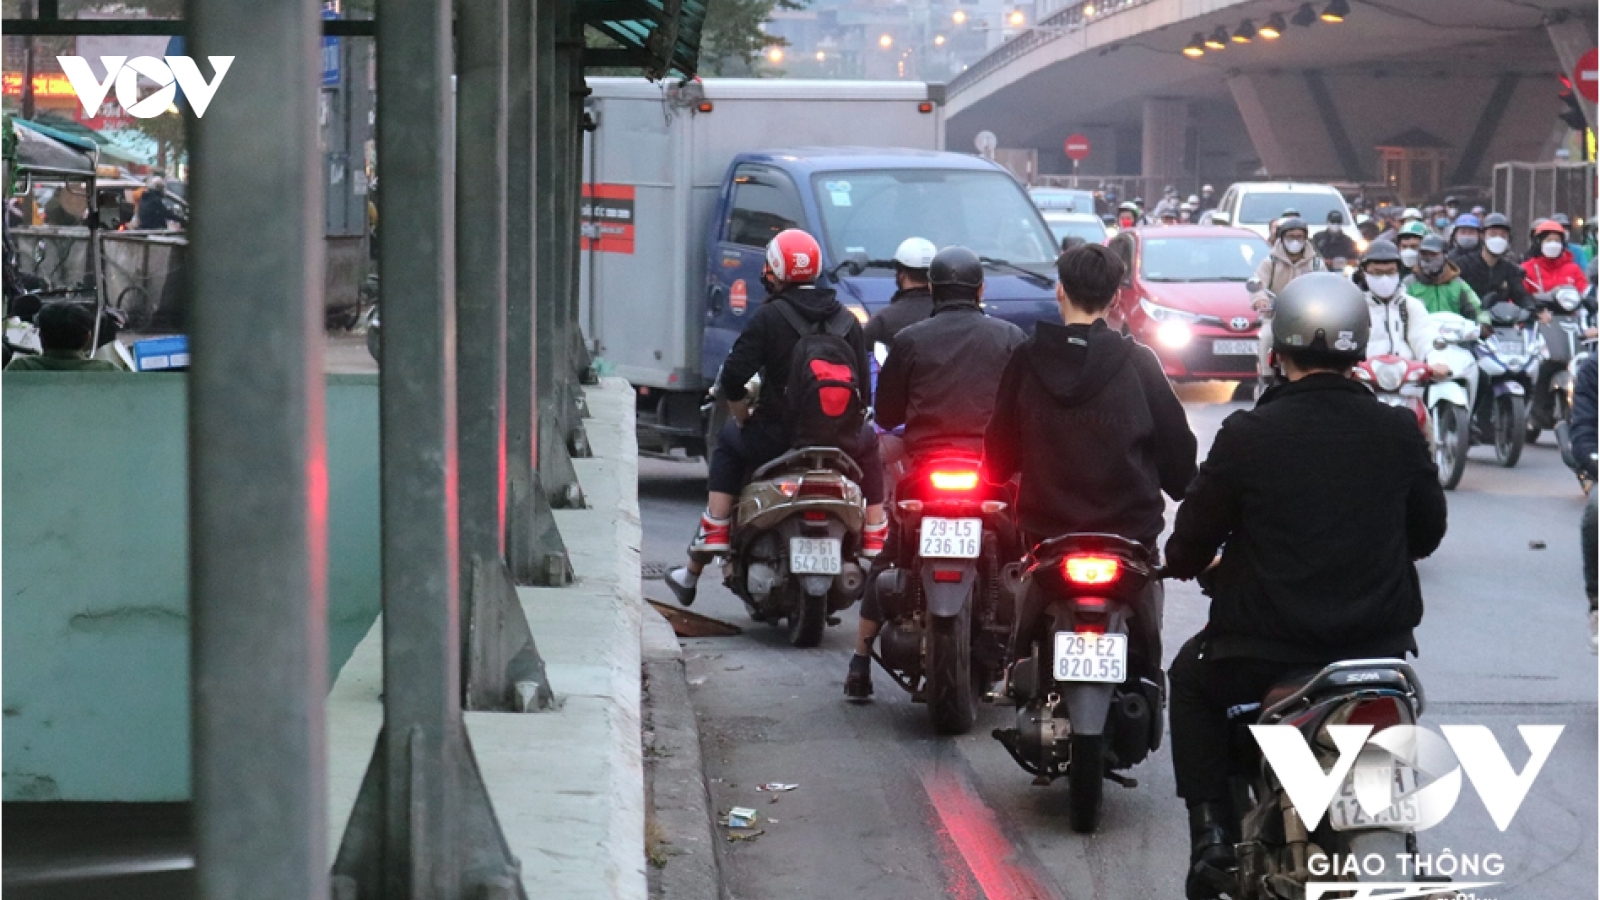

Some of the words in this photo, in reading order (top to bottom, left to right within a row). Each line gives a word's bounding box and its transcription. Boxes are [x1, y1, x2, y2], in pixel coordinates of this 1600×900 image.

[929, 520, 972, 537] 29-L5
[924, 537, 976, 555] 236.16
[794, 555, 838, 571] 542.06
[1065, 636, 1115, 657] 29-E2
[1059, 657, 1121, 679] 820.55
